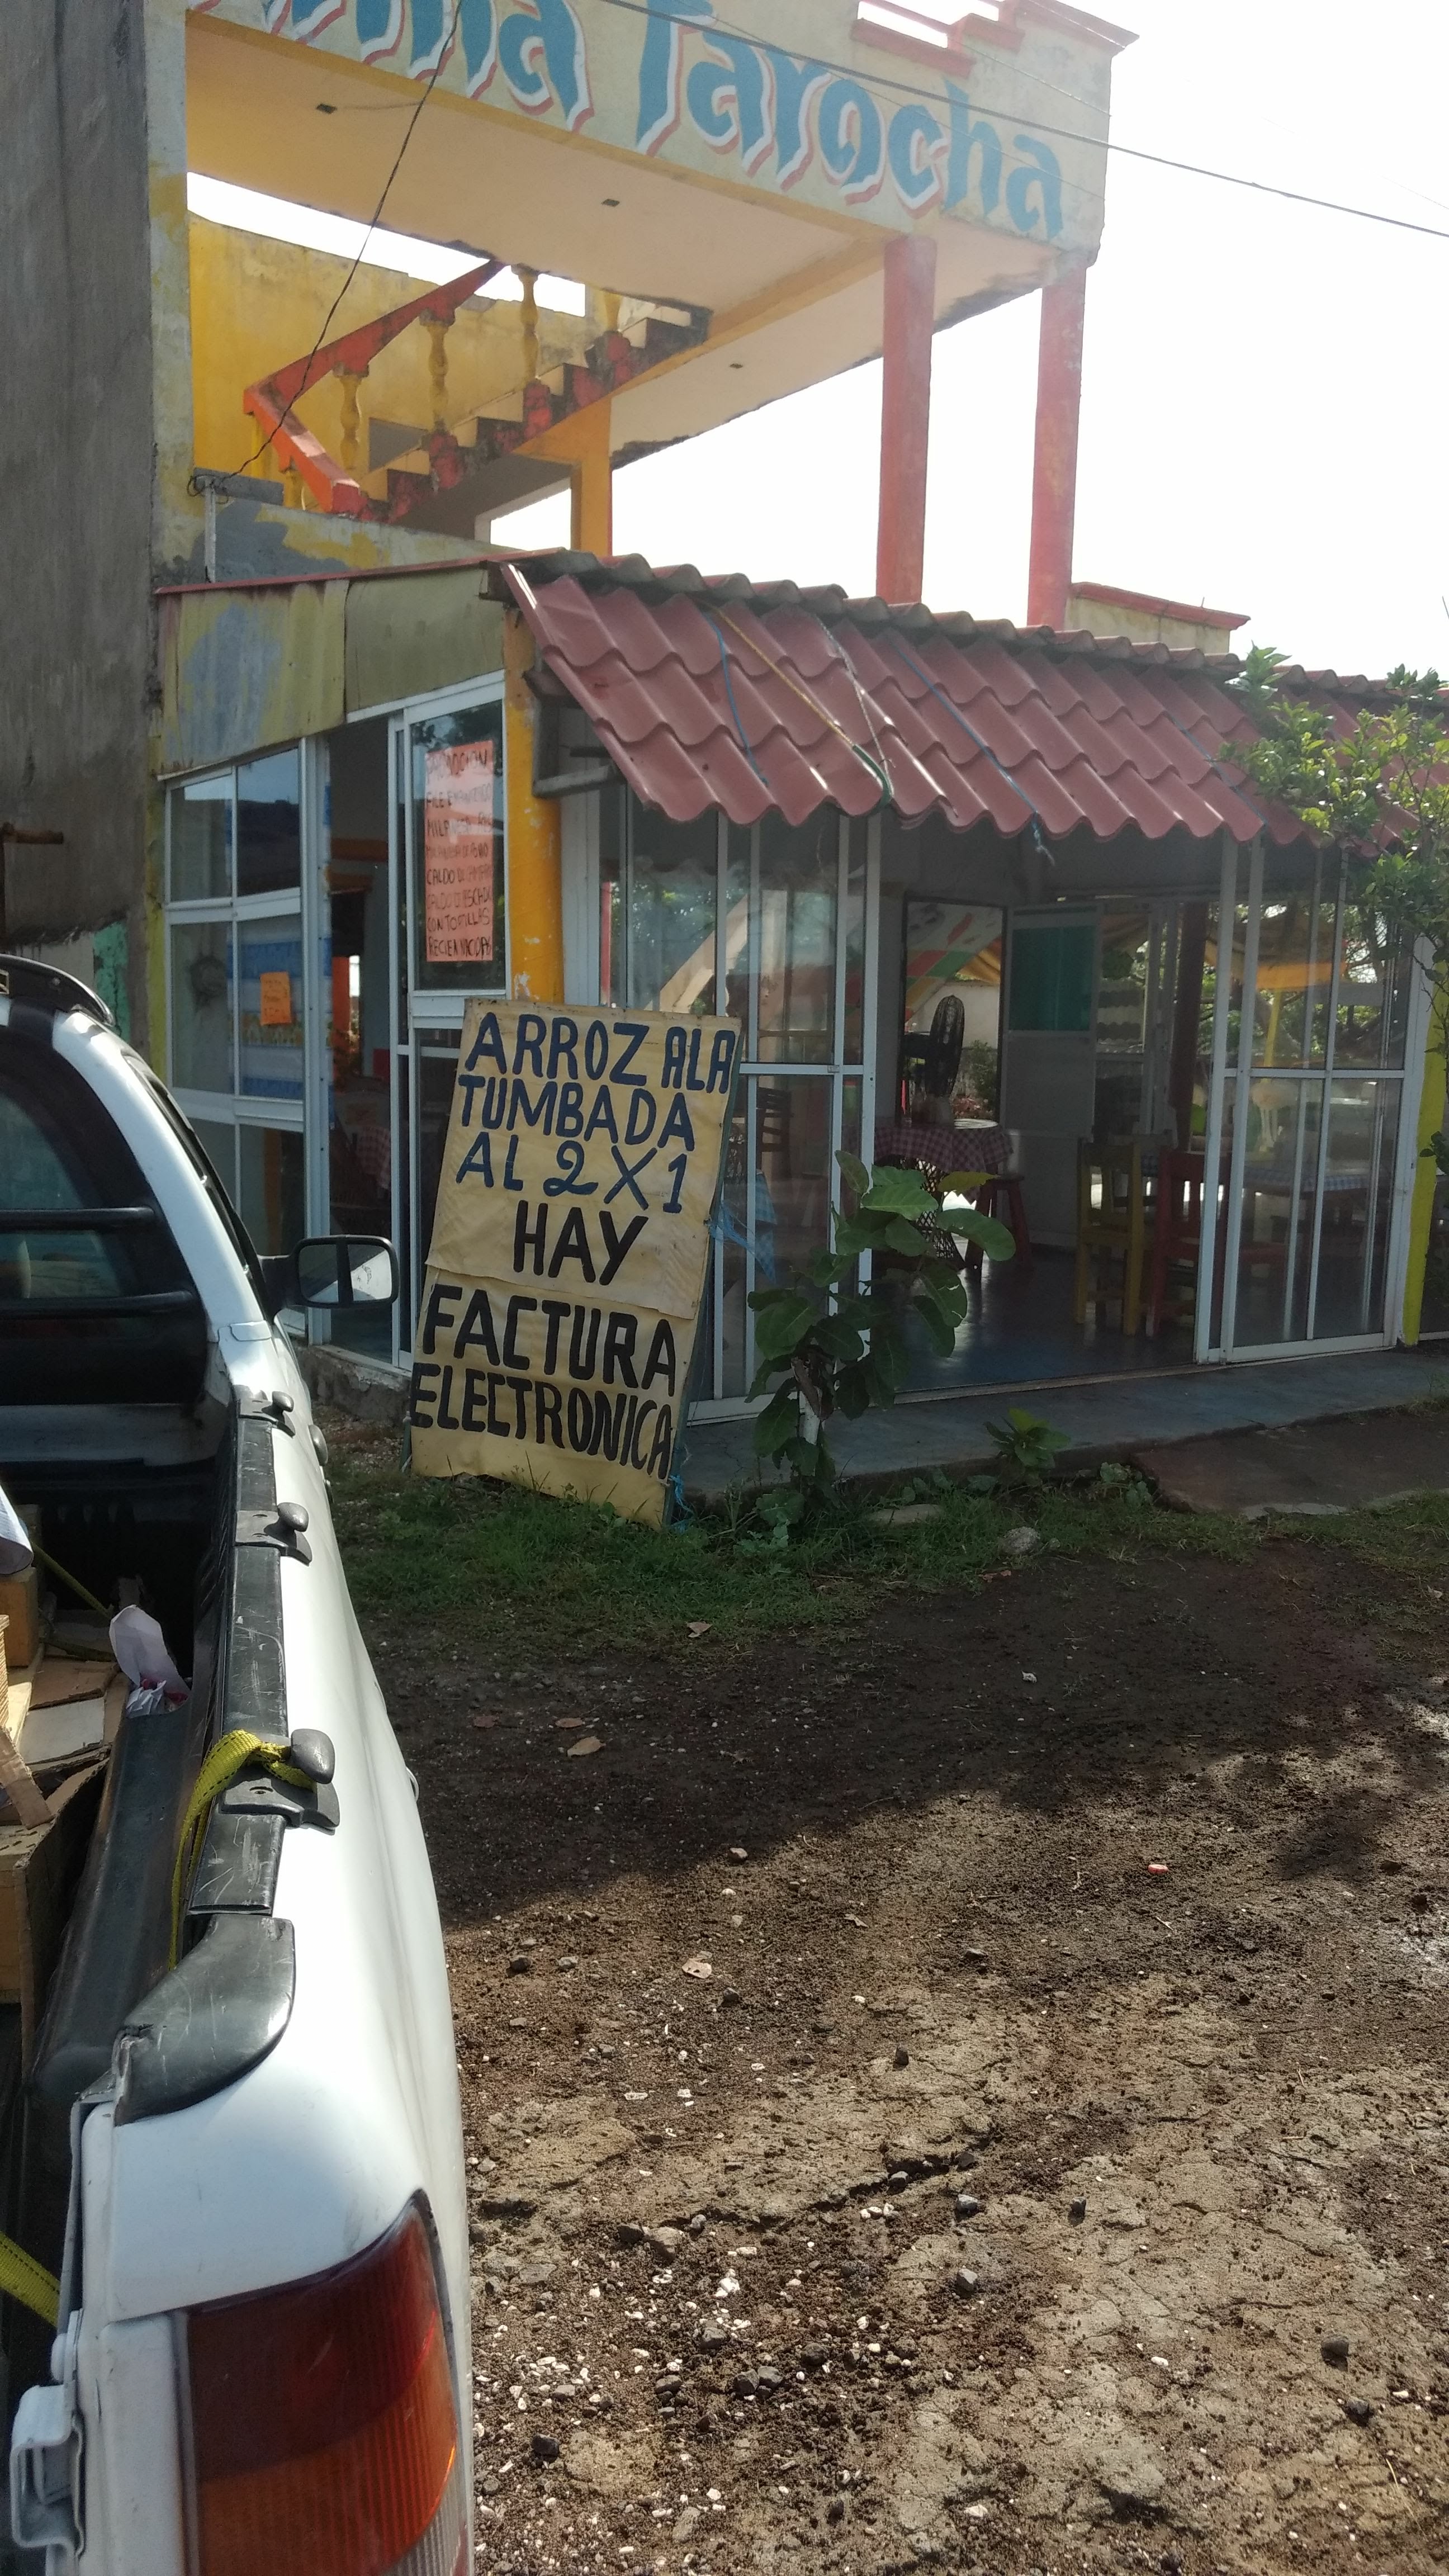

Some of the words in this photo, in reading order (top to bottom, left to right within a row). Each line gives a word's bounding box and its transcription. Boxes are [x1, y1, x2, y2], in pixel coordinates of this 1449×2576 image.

[426, 868, 455, 886] CALDO
[427, 917, 443, 932] CON
[465, 1012, 649, 1087] ARROZ
[458, 1075, 695, 1152] TUMBADA
[456, 1132, 524, 1192] AL
[513, 1200, 648, 1286] HAY
[423, 1284, 675, 1397] FACTURA
[411, 1362, 671, 1480] ELECTRONICA
